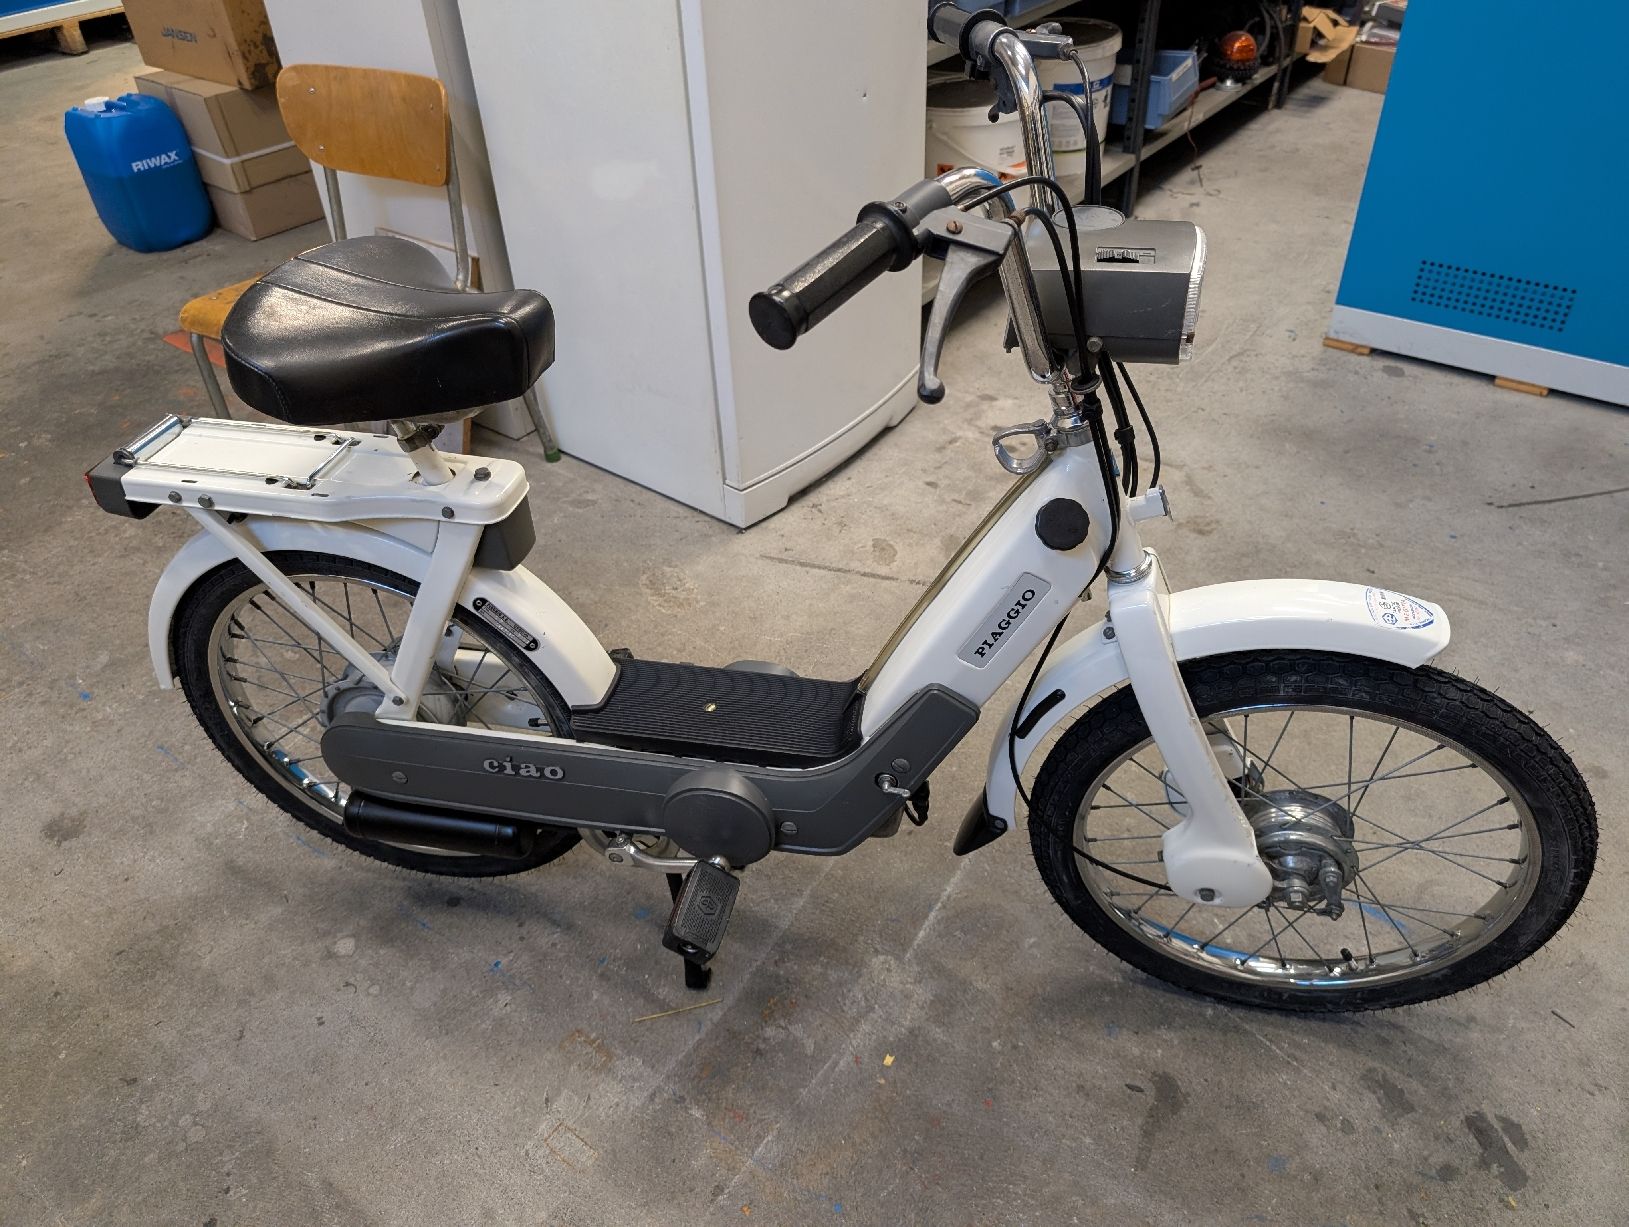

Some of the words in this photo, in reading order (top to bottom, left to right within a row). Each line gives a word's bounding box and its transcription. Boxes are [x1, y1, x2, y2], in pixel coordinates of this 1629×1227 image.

[131, 150, 179, 173] RIWAX
[974, 589, 1036, 658] PIAGGIO
[483, 756, 564, 779] ciao
